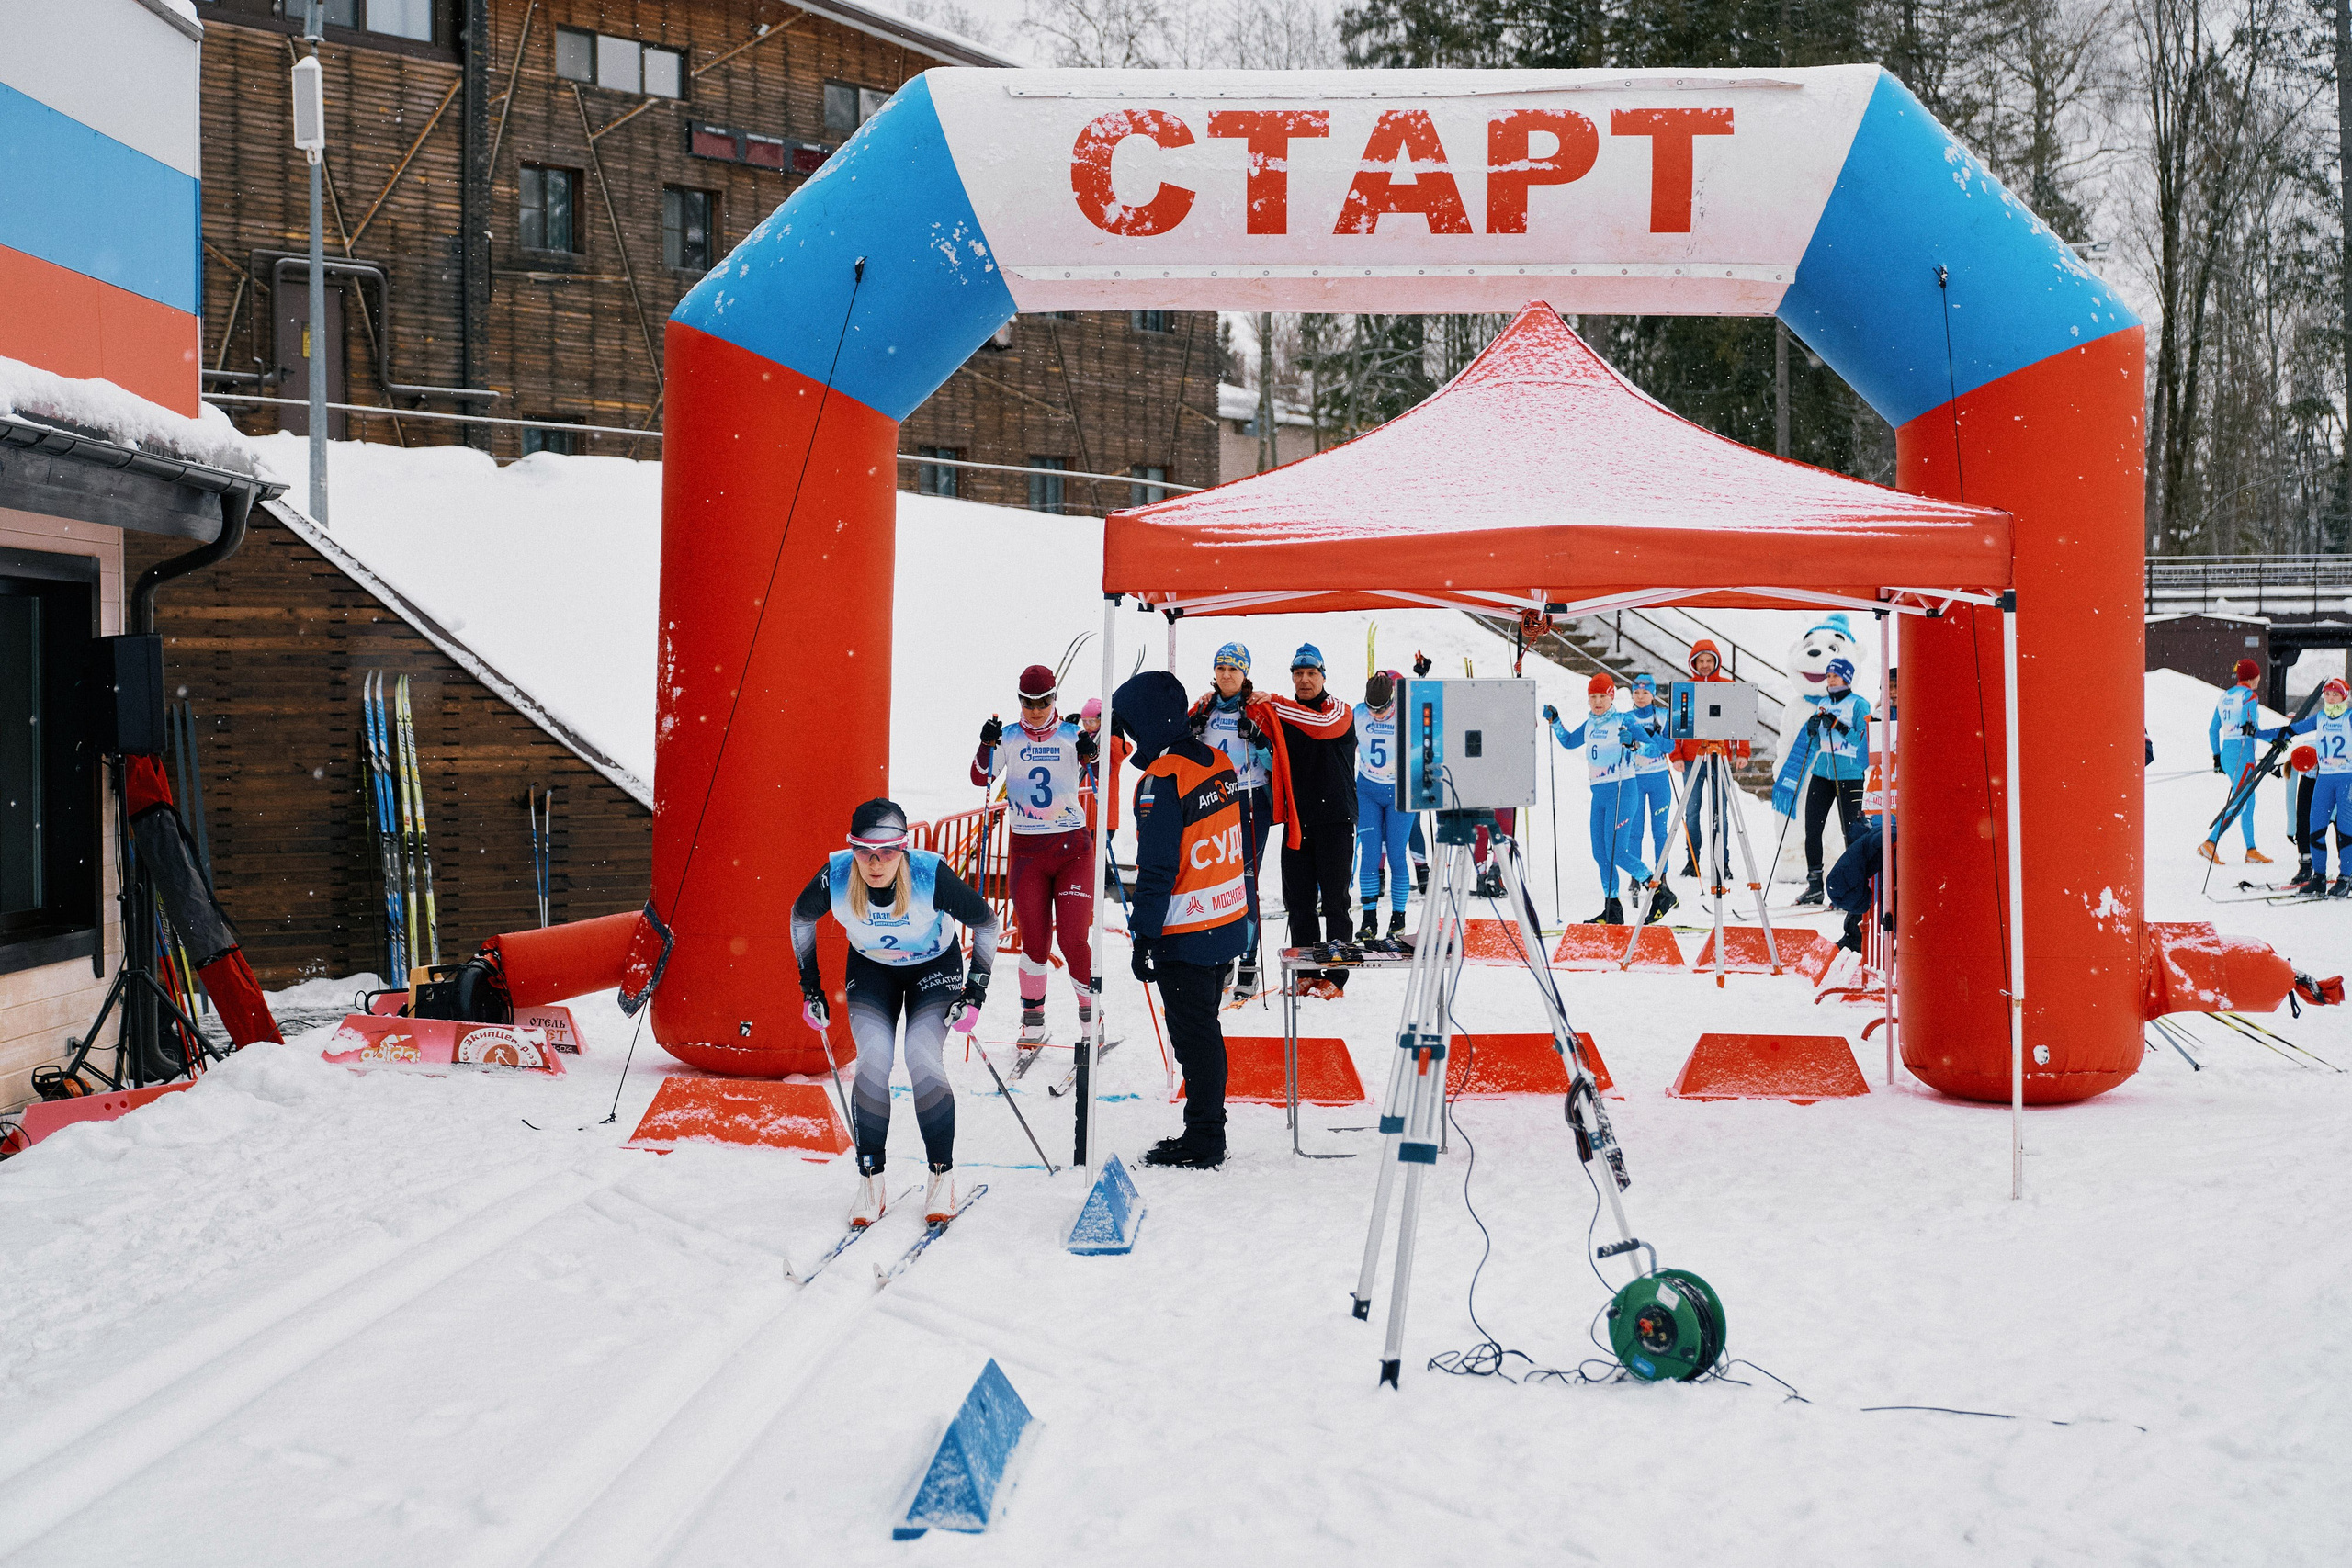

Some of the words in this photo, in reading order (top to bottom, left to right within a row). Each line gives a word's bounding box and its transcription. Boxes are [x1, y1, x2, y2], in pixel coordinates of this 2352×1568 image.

[1071, 108, 1735, 236] СТАРТ
[1370, 739, 1386, 768] 5
[1591, 745, 1598, 760] 6
[2321, 736, 2346, 759] 12
[1028, 766, 1053, 808] 3
[1199, 791, 1219, 809] Arta
[1191, 822, 1243, 870] СУД
[1058, 891, 1091, 899] NORDSKI
[880, 935, 900, 950] 2
[917, 971, 944, 986] TEAM
[921, 974, 963, 992] MARATHON
[529, 1017, 566, 1029] ОТЕЛЬ
